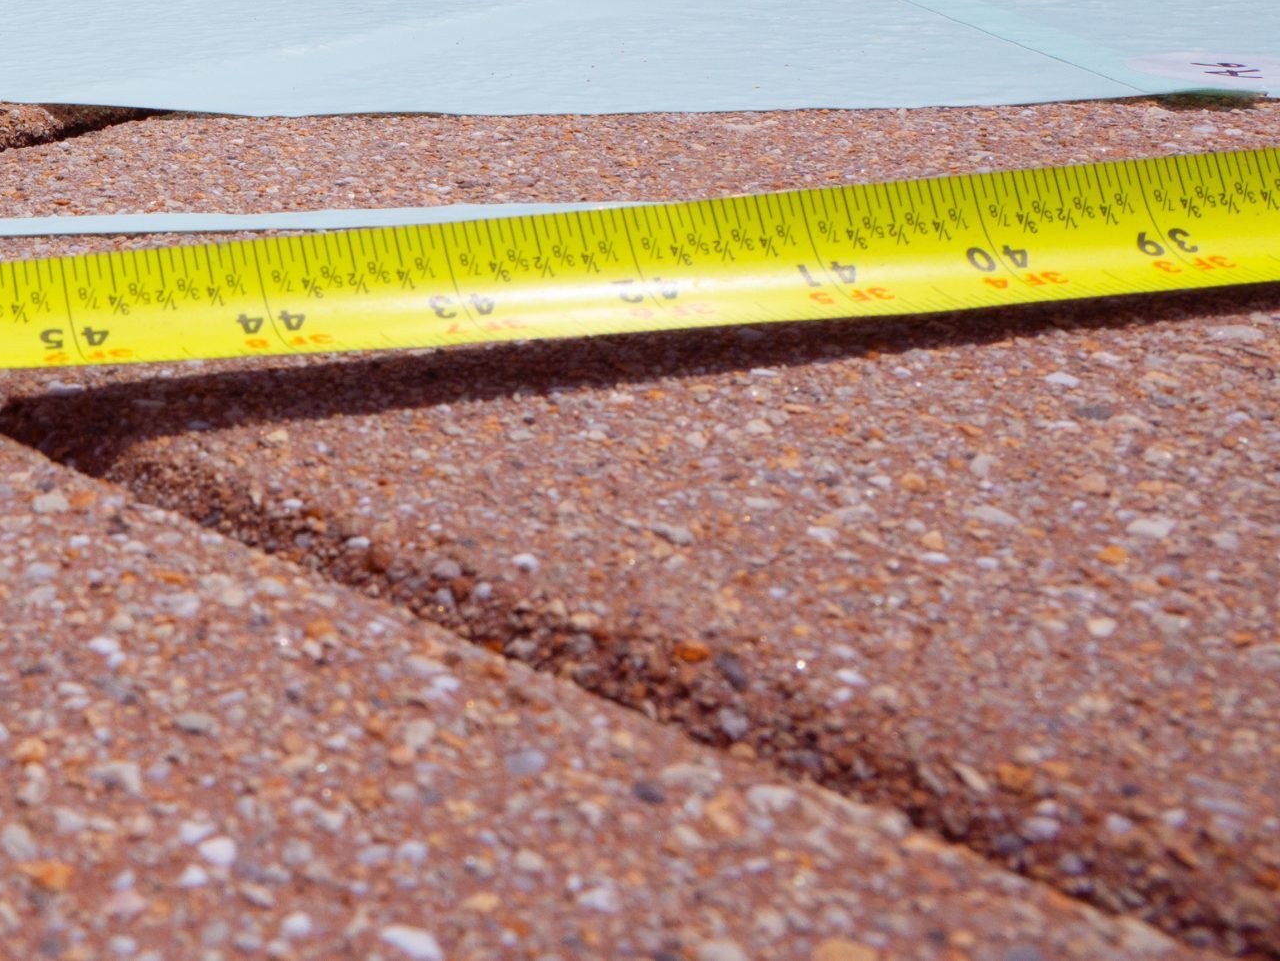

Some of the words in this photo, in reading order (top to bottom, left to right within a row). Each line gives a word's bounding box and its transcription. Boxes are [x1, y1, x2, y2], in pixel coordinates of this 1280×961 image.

[1136, 228, 1199, 257] 39
[966, 245, 1029, 272] 40
[797, 261, 857, 288] 41
[429, 293, 495, 319] 43
[236, 310, 306, 335] 44
[39, 326, 109, 350] 45
